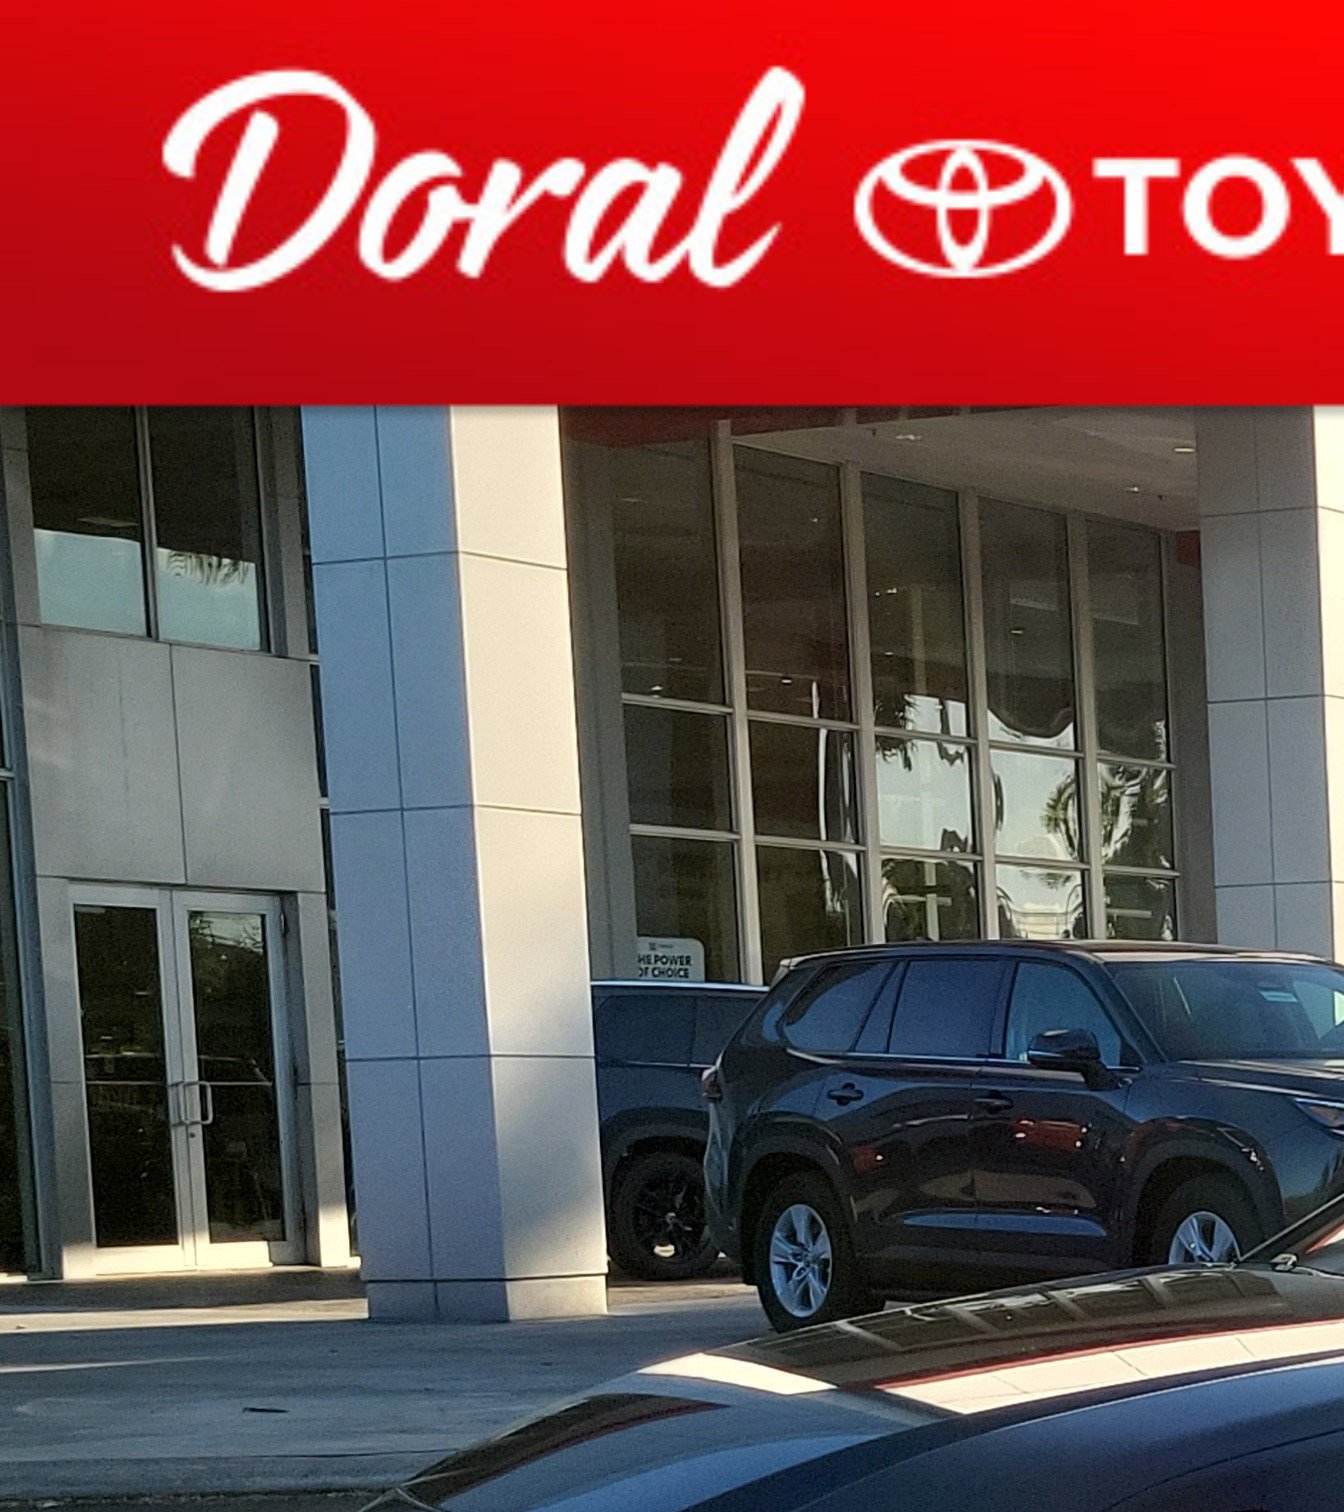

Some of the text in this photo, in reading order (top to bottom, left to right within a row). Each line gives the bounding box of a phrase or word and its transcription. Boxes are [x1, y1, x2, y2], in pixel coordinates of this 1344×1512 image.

[637, 954, 692, 966] HE POWER
[652, 967, 690, 979] CHOICE
